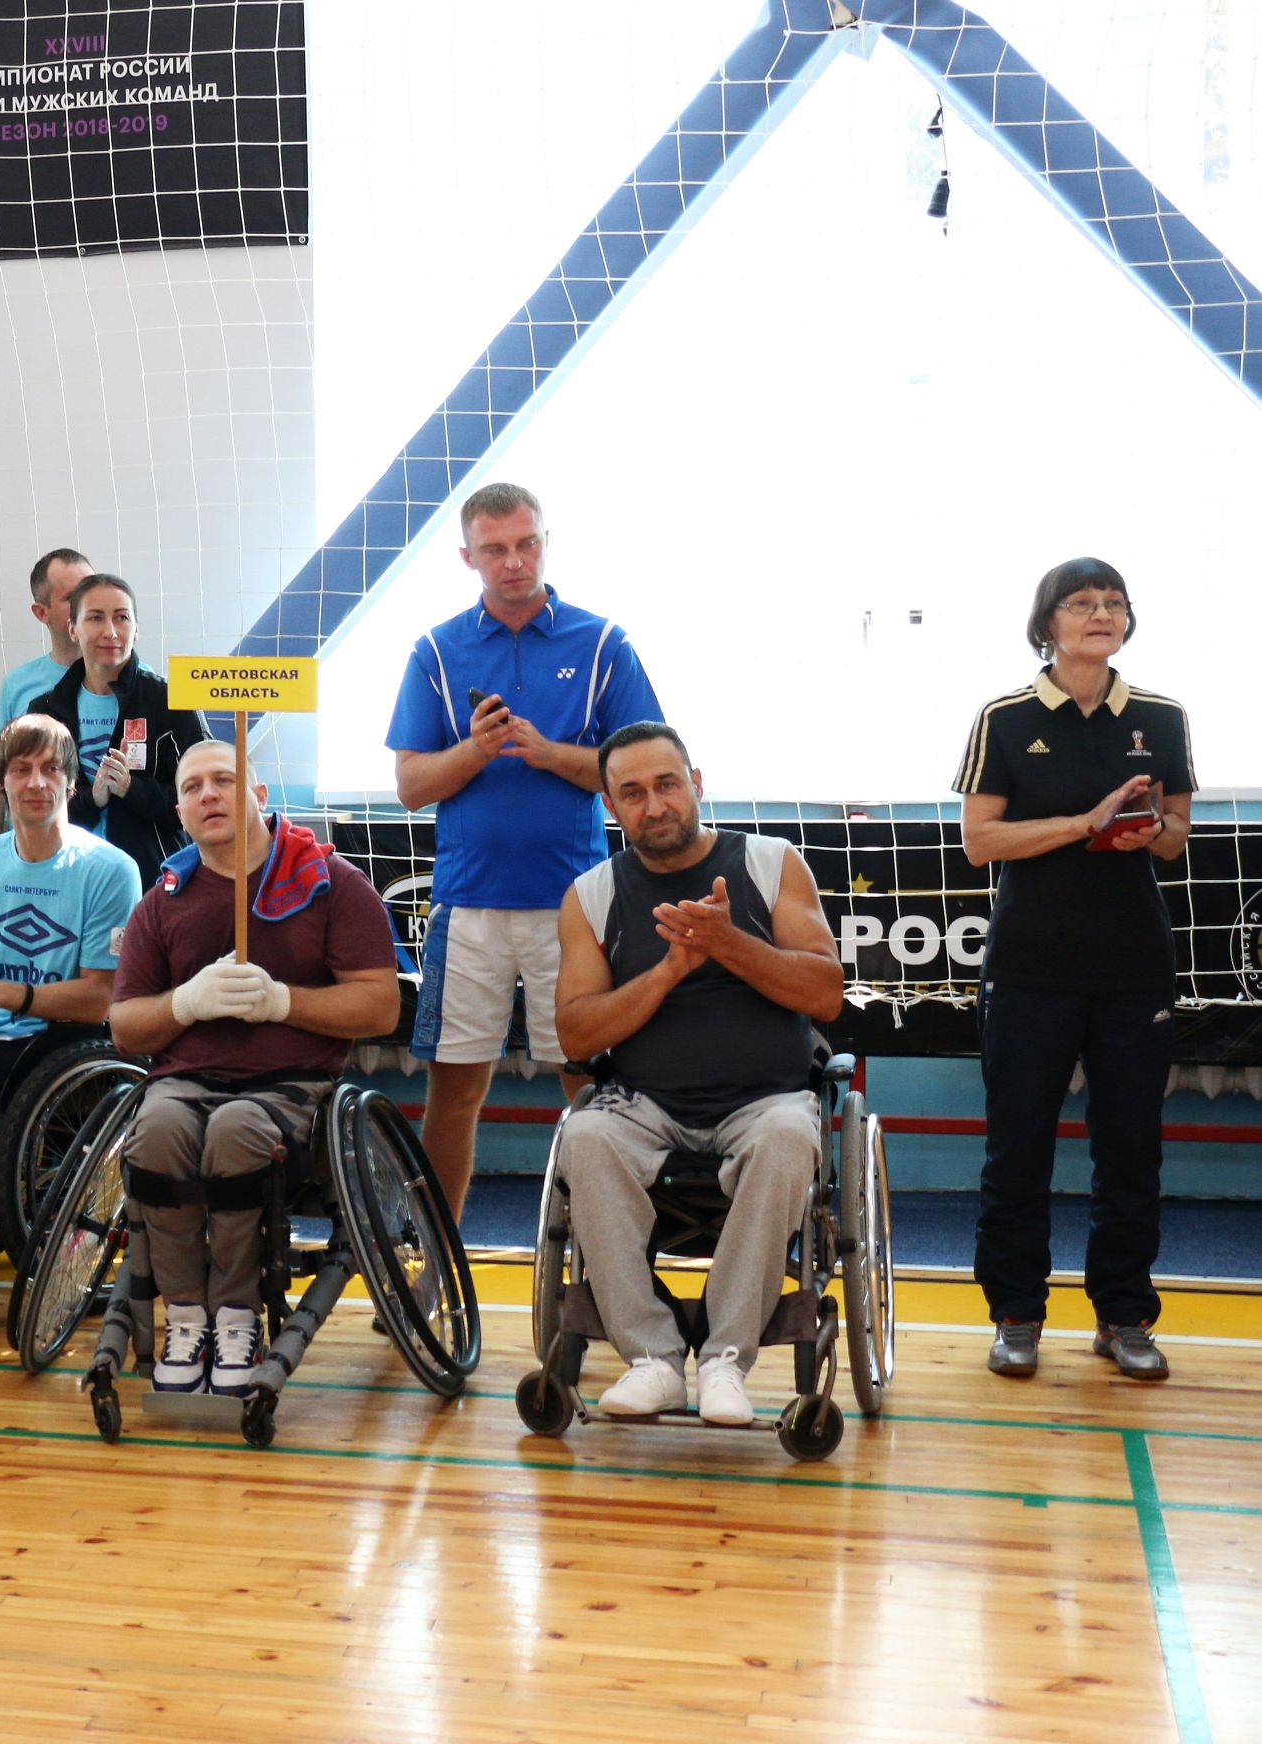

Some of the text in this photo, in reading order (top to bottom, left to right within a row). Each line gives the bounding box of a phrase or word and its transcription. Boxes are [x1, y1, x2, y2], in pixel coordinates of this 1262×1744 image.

[44, 35, 105, 55] XXVIII
[100, 57, 190, 79] РОССИИ
[12, 89, 118, 112] МУЖСКИХ
[125, 83, 219, 105] КОМАНД
[63, 114, 168, 137] 2018-209
[191, 670, 298, 679] САРАТОВСКАЯ
[210, 688, 279, 698] ОБЛАСТЬ
